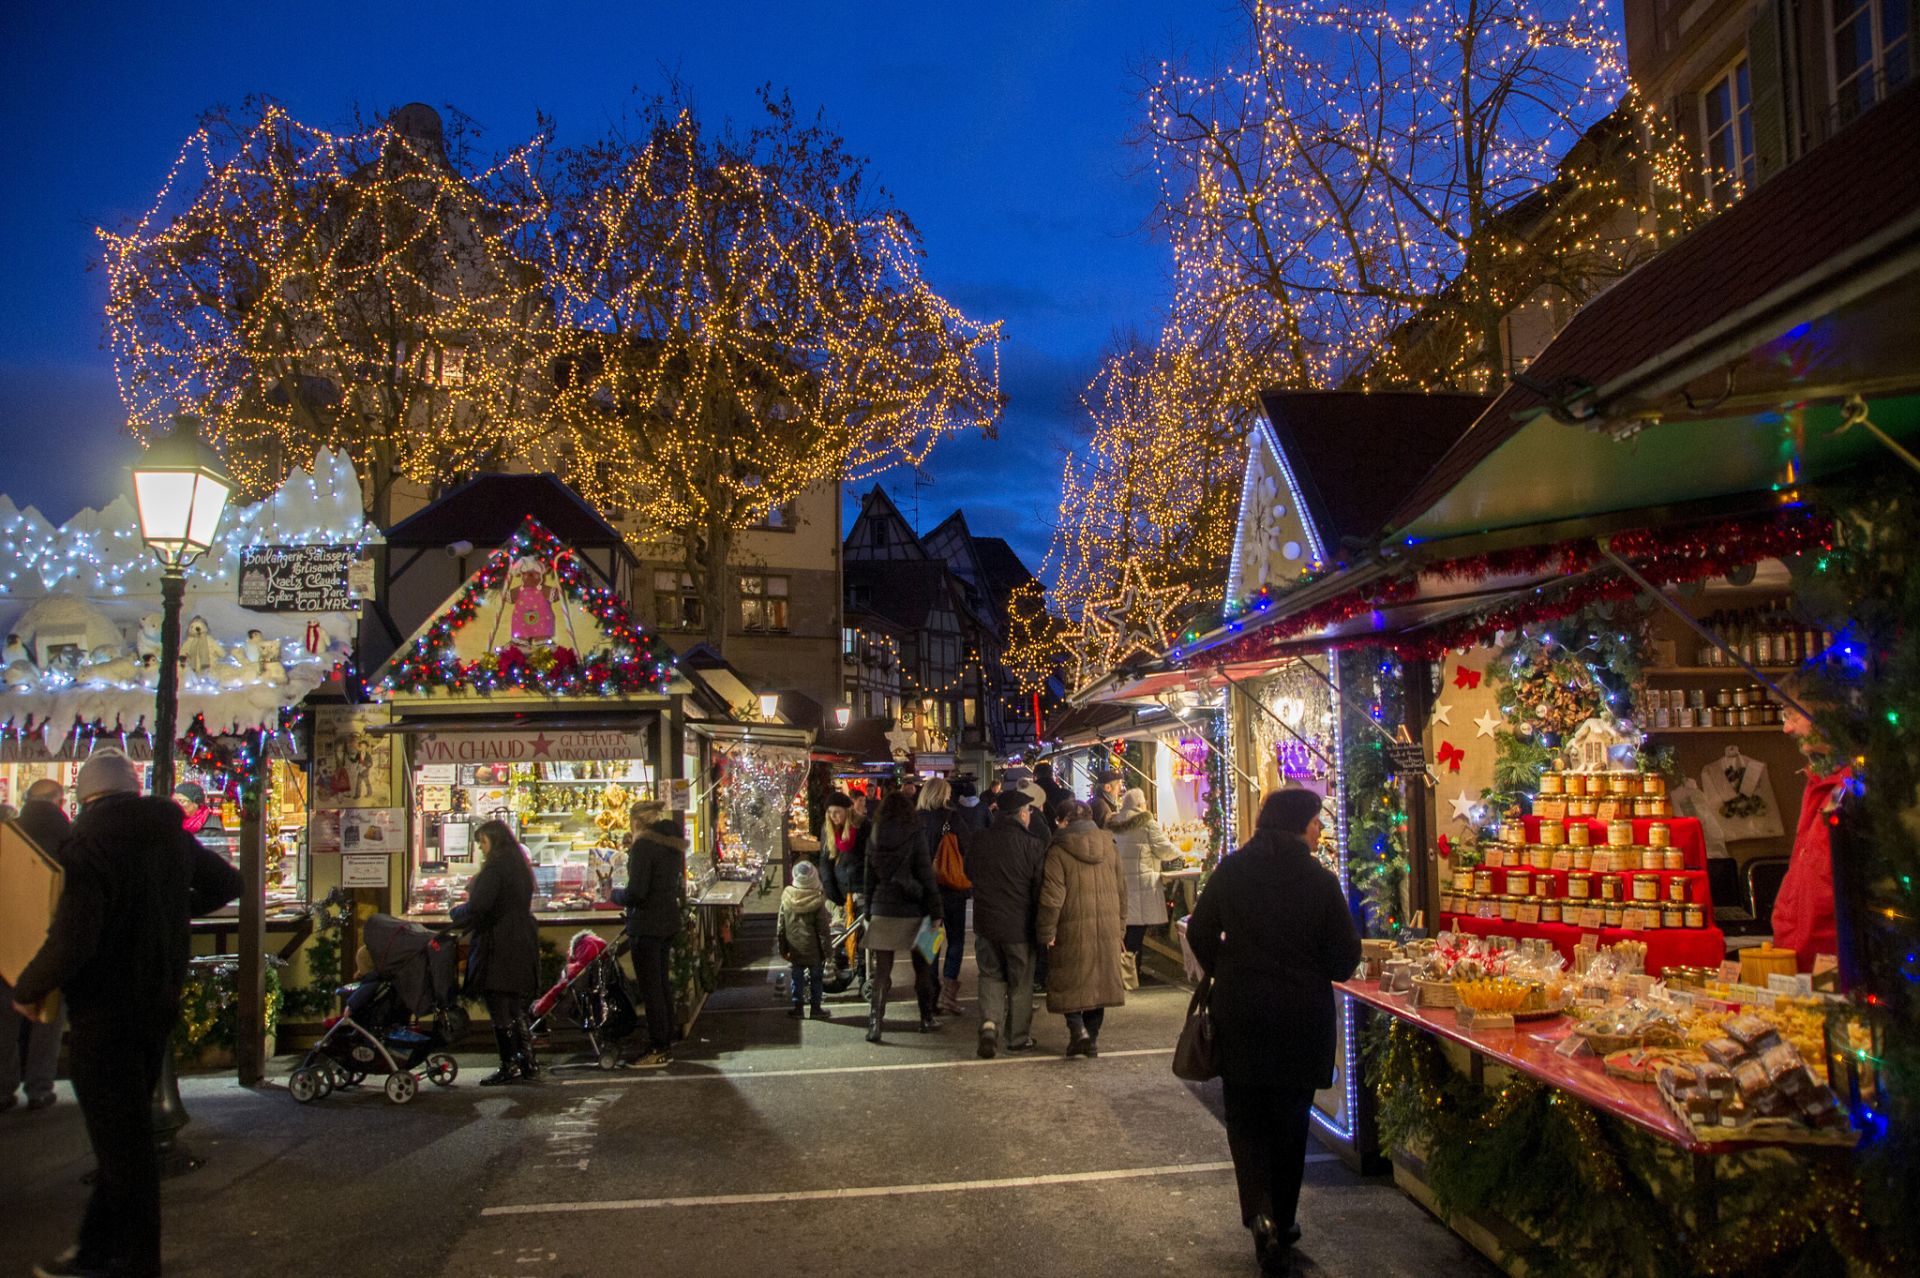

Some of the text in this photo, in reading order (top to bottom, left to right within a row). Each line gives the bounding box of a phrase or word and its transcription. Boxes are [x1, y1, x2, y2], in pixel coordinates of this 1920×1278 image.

[305, 573, 341, 590] Claude
[267, 591, 276, 603] 6
[297, 598, 352, 611] COLMAR
[425, 740, 525, 761] VIN CHAUD
[557, 748, 585, 761] VINO
